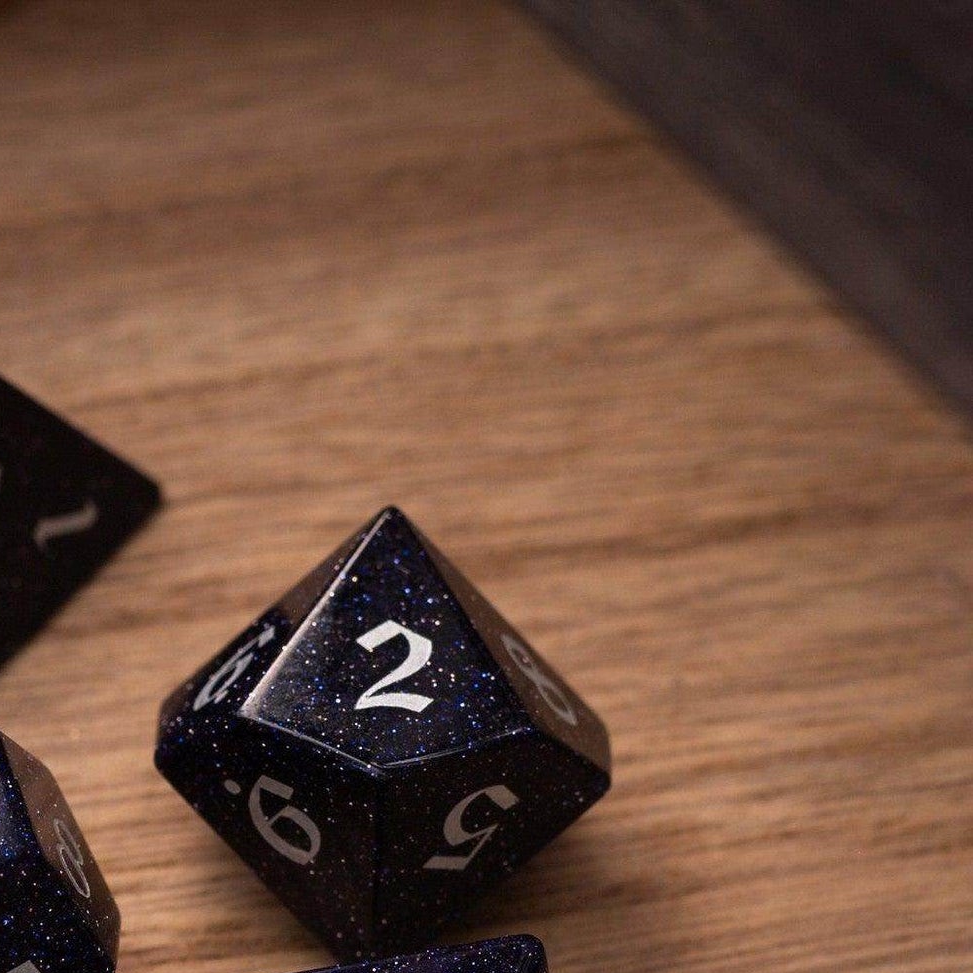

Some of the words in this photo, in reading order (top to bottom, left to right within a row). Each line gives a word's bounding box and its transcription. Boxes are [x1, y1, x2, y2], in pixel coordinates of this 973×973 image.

[33, 500, 97, 548] 1
[354, 619, 435, 712] 2
[501, 634, 577, 726] 8
[423, 785, 519, 870] 5
